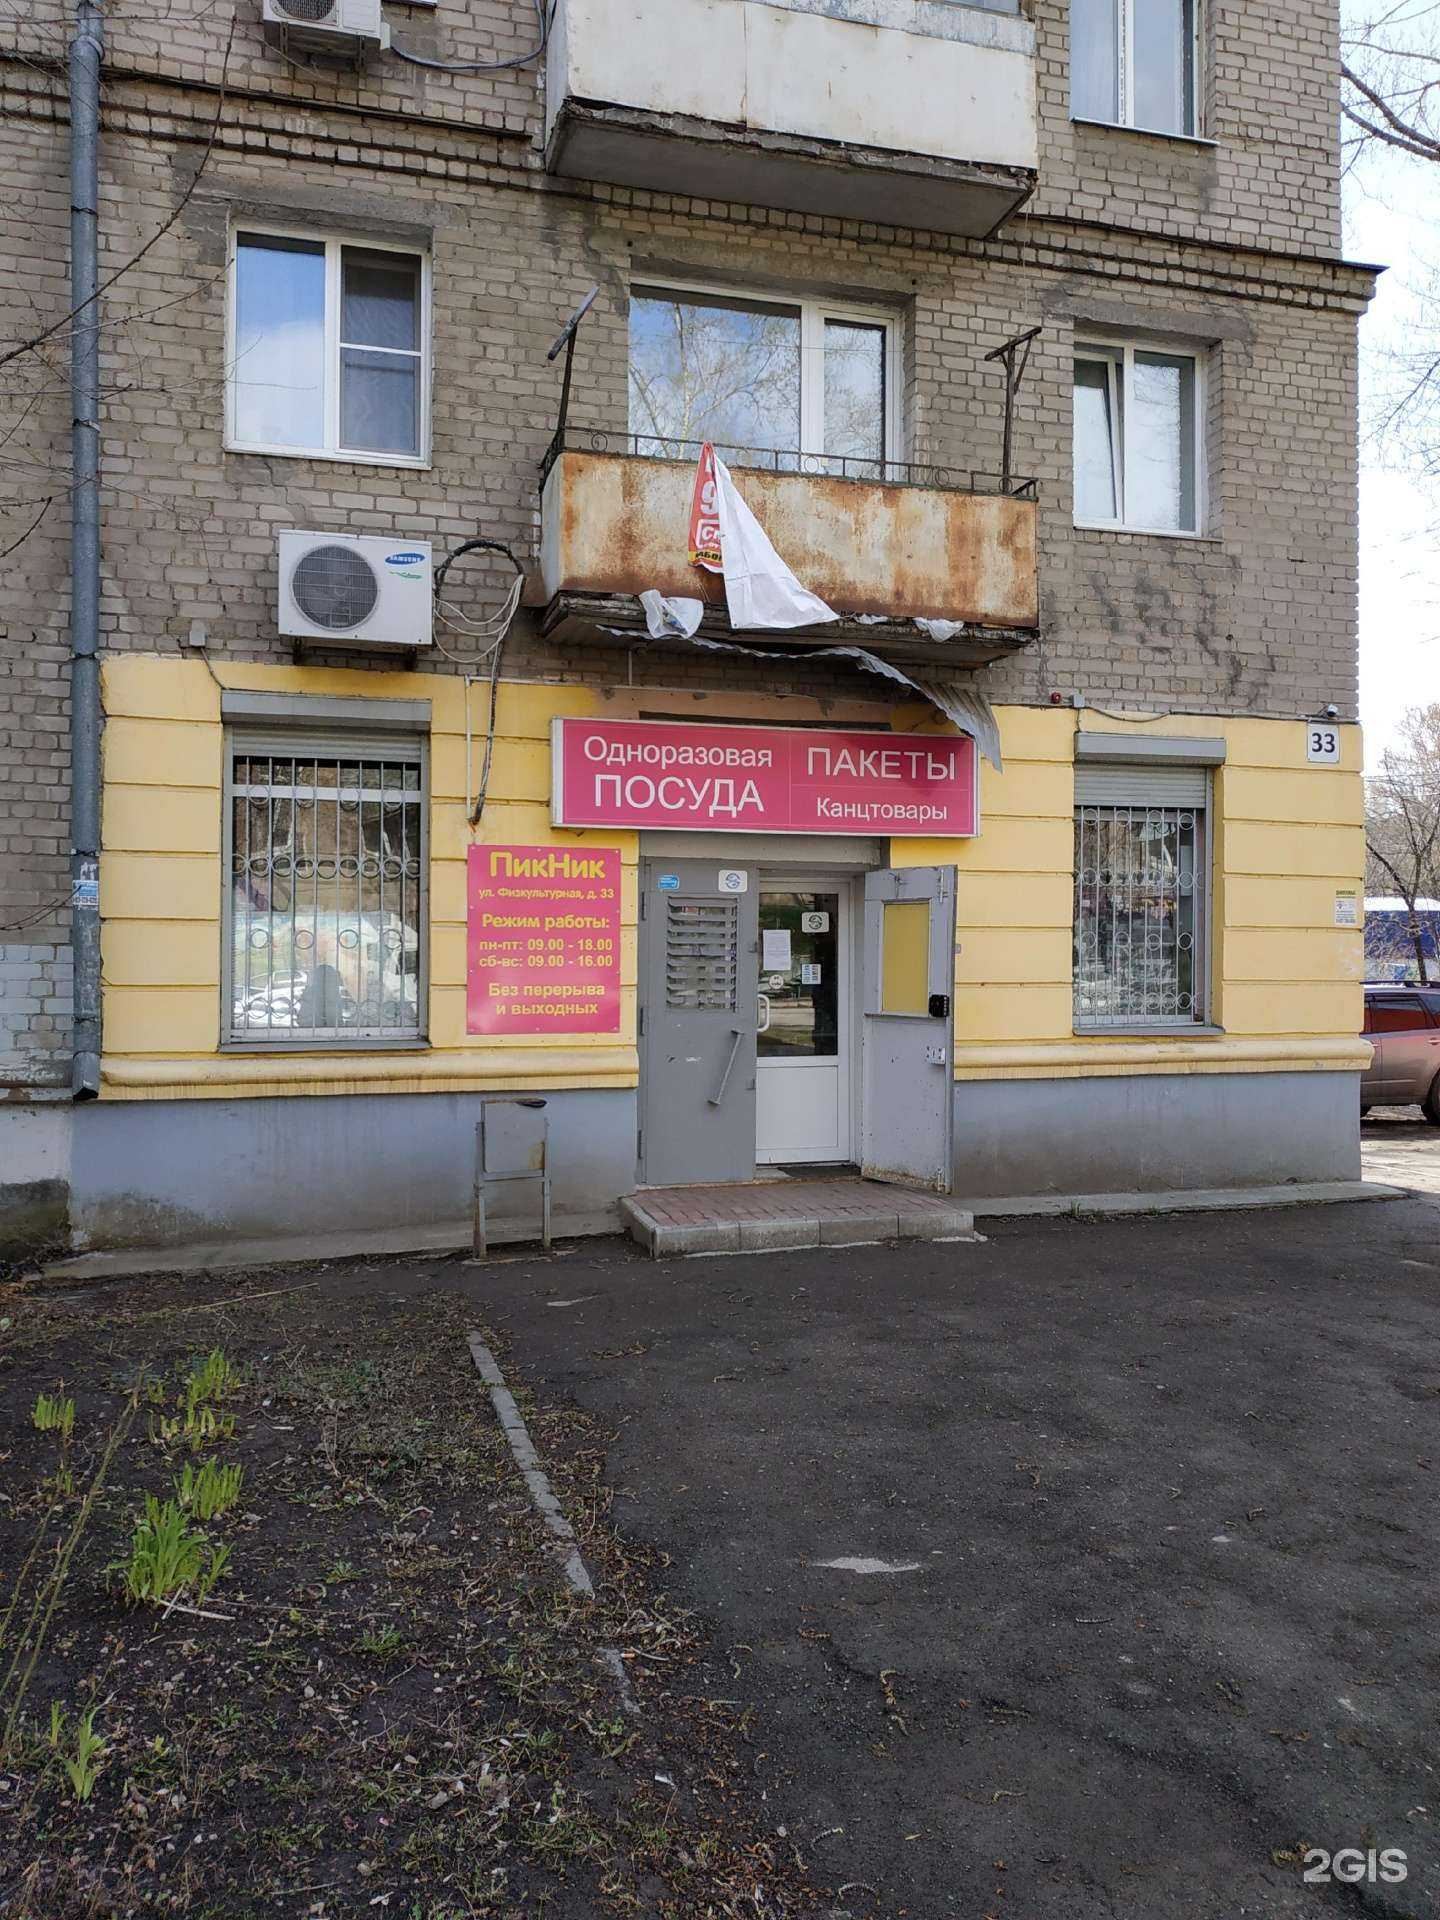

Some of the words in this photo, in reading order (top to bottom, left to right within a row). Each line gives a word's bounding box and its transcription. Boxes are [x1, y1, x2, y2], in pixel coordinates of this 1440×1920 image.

[1311, 732, 1335, 753] 33
[583, 735, 773, 770] Одноразовая
[807, 747, 956, 781] ПАКЕТЫ
[594, 774, 765, 818] ПОСУДА
[816, 797, 948, 822] Канцтовары
[489, 851, 606, 879] ПикНик
[478, 888, 495, 899] ул.
[600, 888, 615, 899] 33
[482, 913, 541, 928] Режим
[544, 915, 610, 931] работы:
[479, 941, 524, 951] пн-пт:
[527, 938, 564, 950] 09.00
[577, 938, 613, 950] 18.00
[479, 955, 524, 968] сб-вс:
[527, 955, 564, 967] 09.00
[577, 955, 613, 967] 16.00
[488, 982, 519, 997] Без
[523, 985, 606, 998] перерыва
[496, 1004, 507, 1015] и
[511, 1003, 599, 1016] выходных
